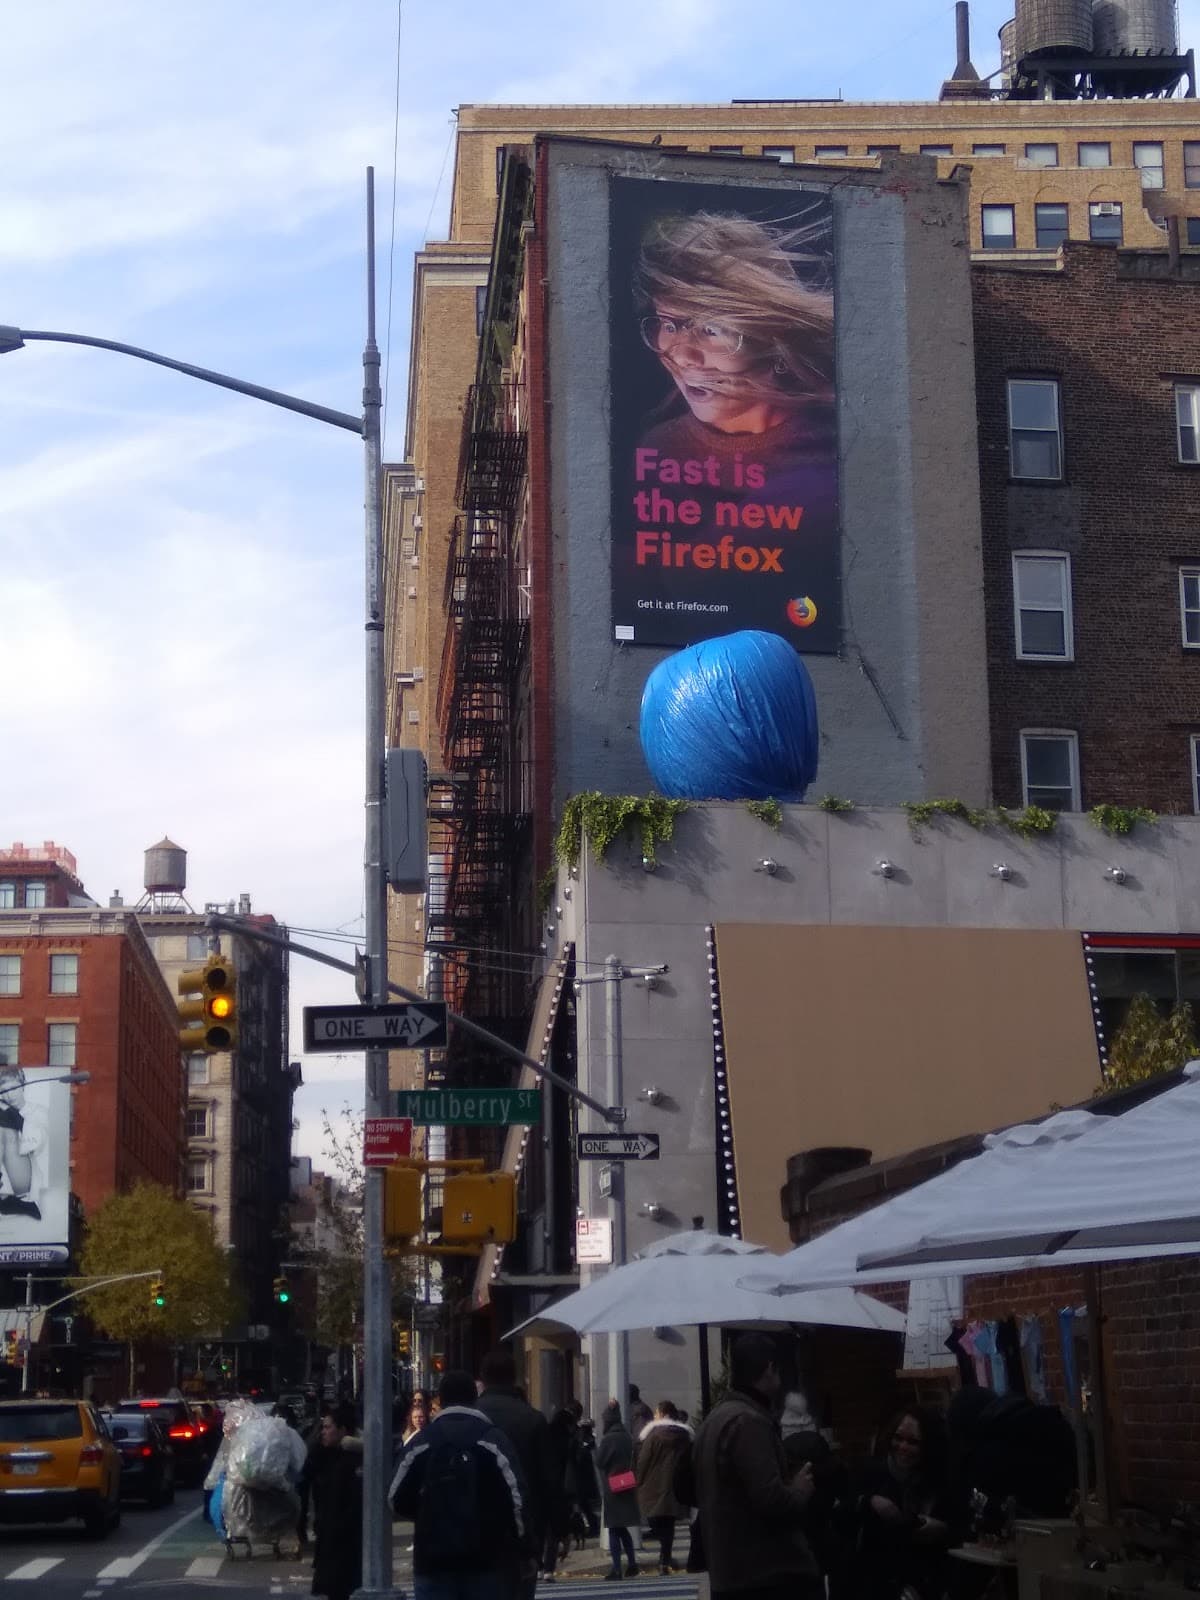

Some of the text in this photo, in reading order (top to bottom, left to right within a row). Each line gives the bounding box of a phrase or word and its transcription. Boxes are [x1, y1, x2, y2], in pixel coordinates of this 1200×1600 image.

[635, 447, 765, 488] Fast is
[633, 488, 803, 530] the new
[636, 531, 784, 573] Firefox
[637, 599, 729, 613] Get it at Firefox.com
[325, 1018, 425, 1037] ONE WAY
[407, 1094, 511, 1125] Mulberry
[366, 1123, 404, 1133] NO STOPPING
[367, 1134, 390, 1144] Anytime
[585, 1141, 648, 1152] ONE WAY
